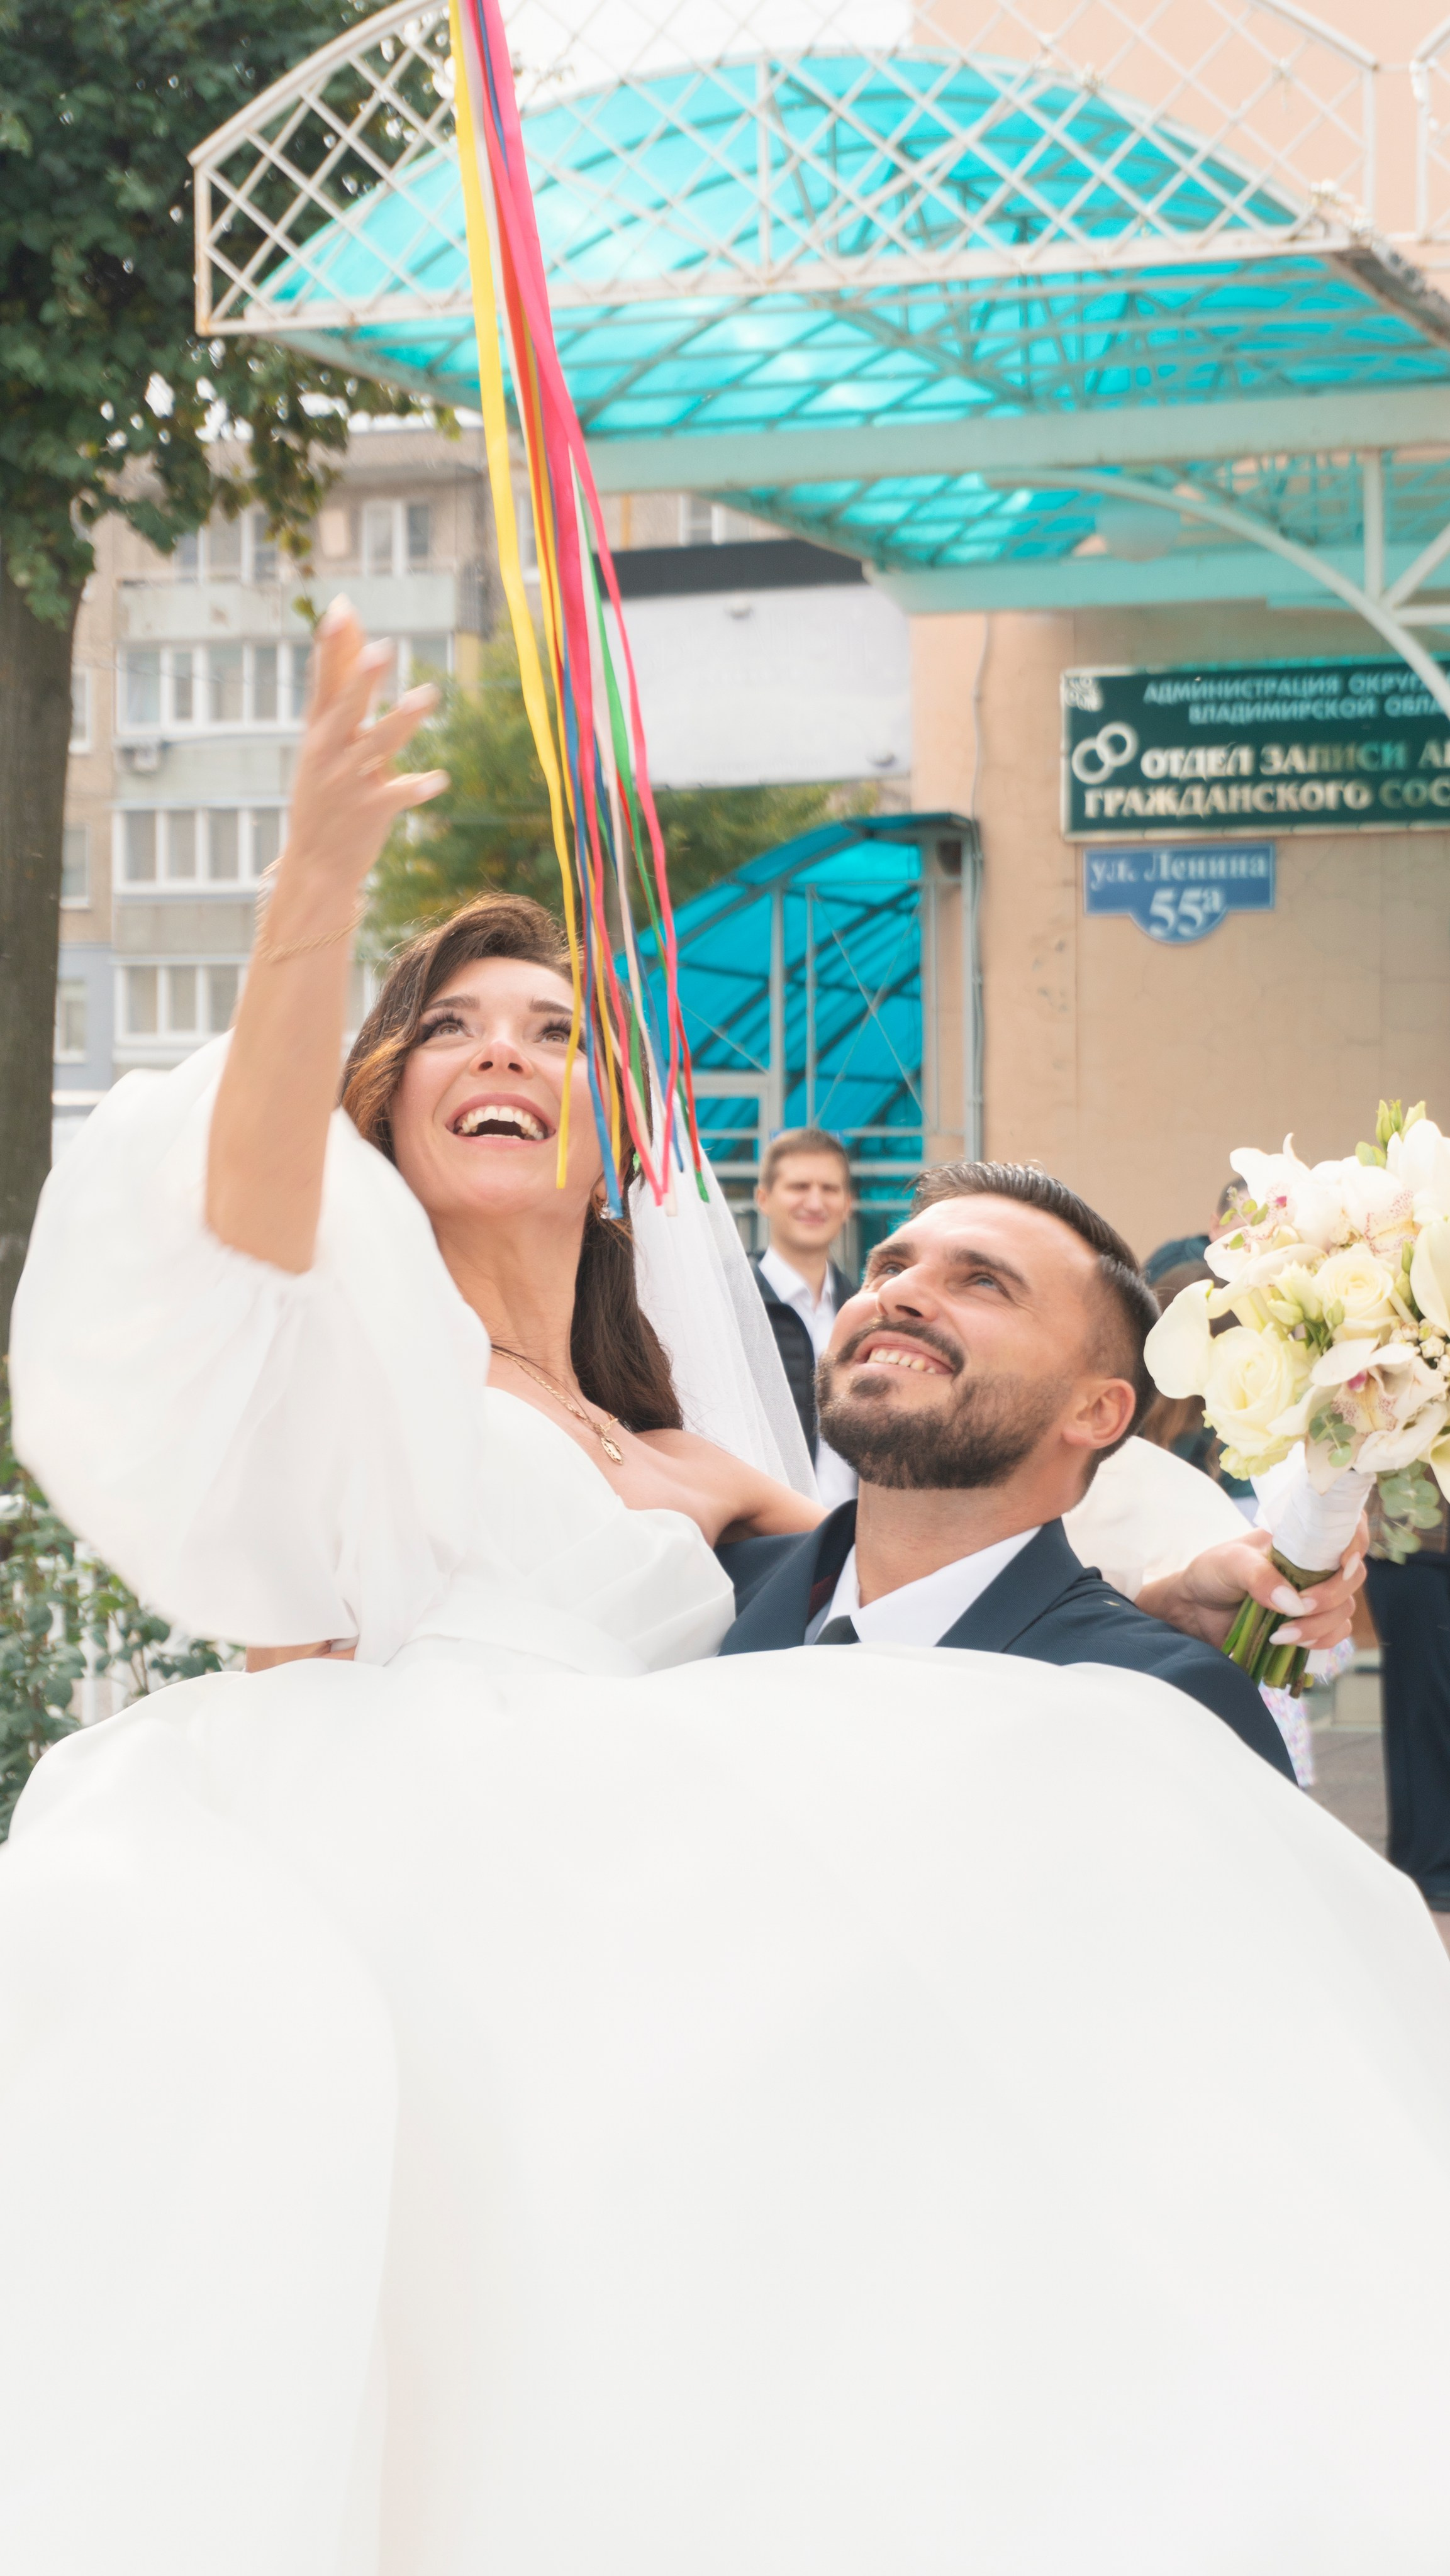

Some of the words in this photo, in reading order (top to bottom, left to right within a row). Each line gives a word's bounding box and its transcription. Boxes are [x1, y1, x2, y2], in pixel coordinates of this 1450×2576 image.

[1143, 674, 1340, 705] АДМИНИСТРАЦИЯ
[1347, 672, 1428, 694] ОКРУГ
[1188, 694, 1377, 725] ВЛАДИМИРСКОЙ
[1140, 742, 1254, 781] ОТДЕЛ
[1259, 740, 1408, 775] ЗАПИСИ
[1417, 738, 1450, 769] А
[1084, 779, 1373, 819] ГРАЖДАНСКОГО
[1091, 859, 1137, 892] ул.
[1144, 852, 1266, 880] Ленина
[1149, 886, 1222, 938] 55а
